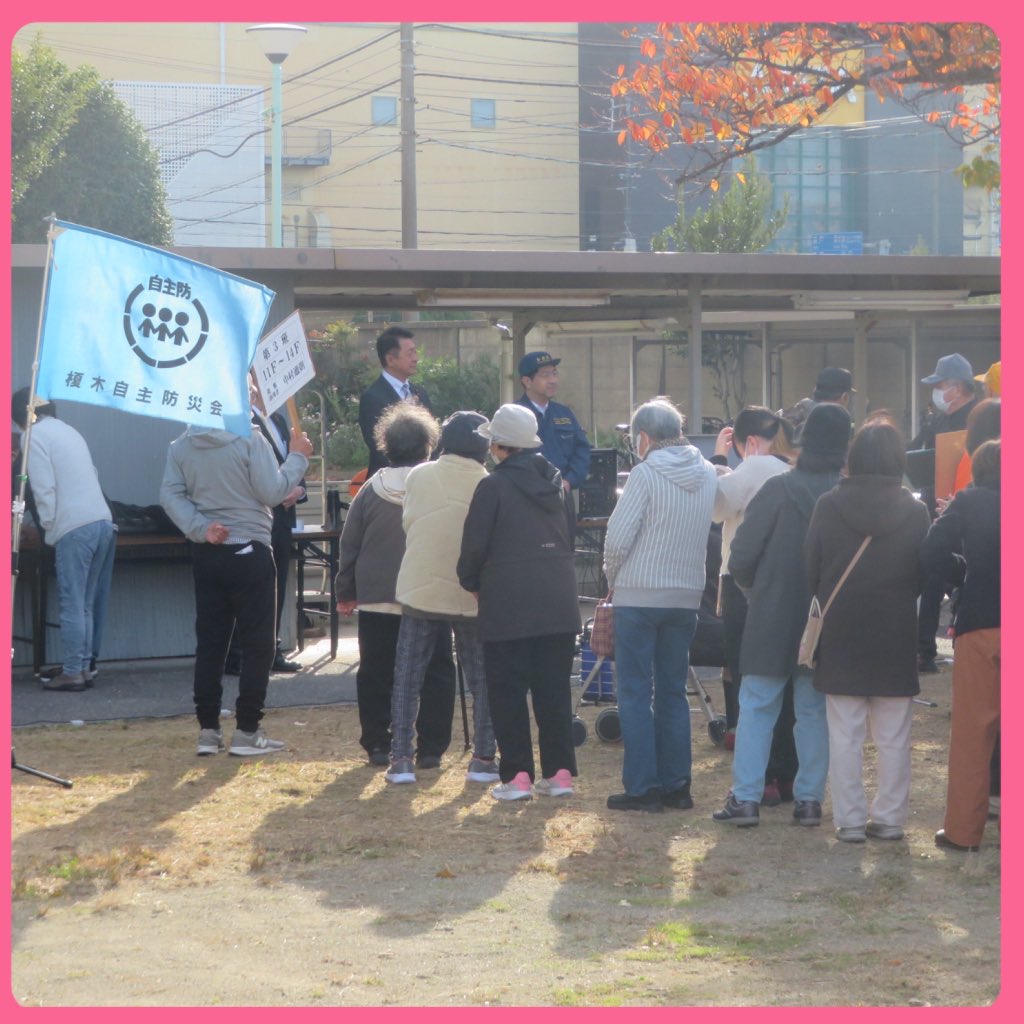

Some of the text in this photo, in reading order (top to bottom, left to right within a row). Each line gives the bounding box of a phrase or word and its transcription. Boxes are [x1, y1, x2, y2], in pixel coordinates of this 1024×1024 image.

[148, 275, 191, 299] 自主防
[66, 370, 223, 417] 榎木自主防災会
